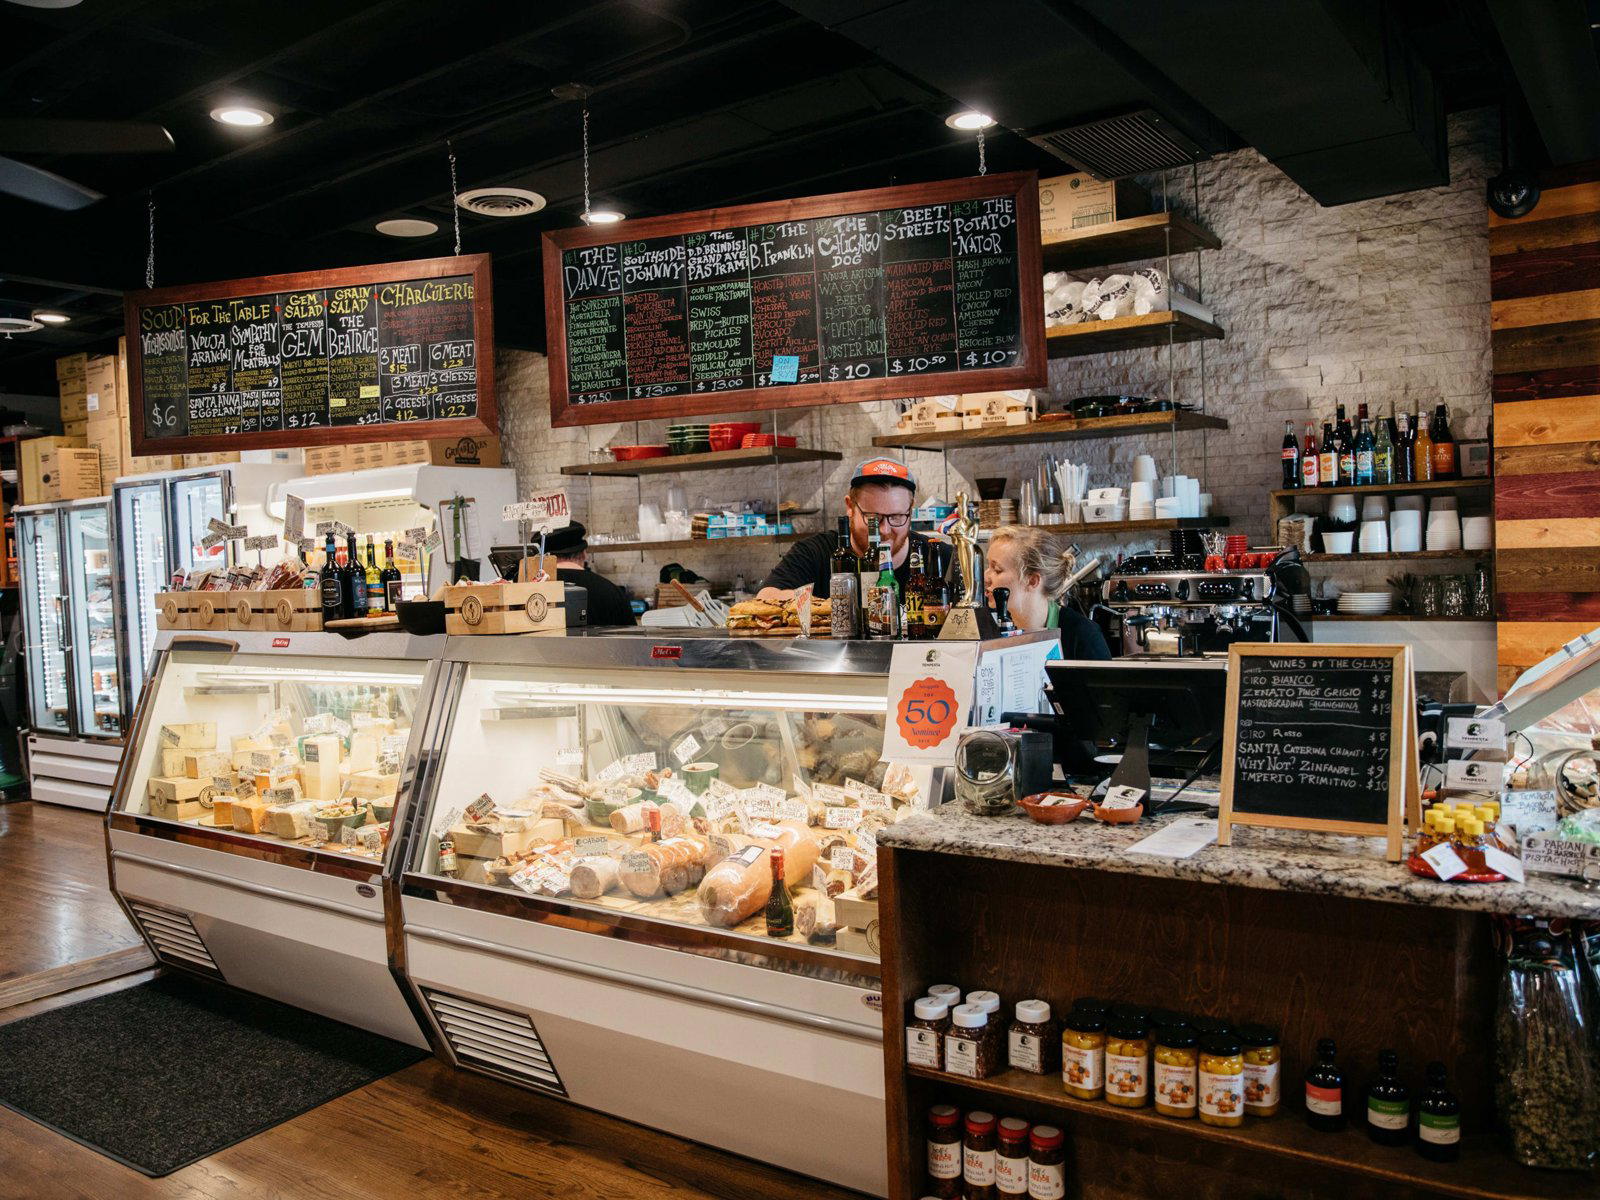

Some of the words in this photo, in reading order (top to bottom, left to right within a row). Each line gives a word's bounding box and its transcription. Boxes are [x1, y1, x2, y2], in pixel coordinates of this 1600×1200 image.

[953, 201, 978, 215] #34
[983, 199, 1013, 213] THE
[884, 211, 902, 223] #7
[902, 206, 946, 224] BEET
[751, 224, 775, 241] #13
[777, 223, 808, 237] THE
[833, 218, 867, 233] THE
[884, 220, 950, 241] STREETS
[688, 234, 706, 246] #99
[710, 231, 735, 240] THE
[818, 233, 880, 256] CHICAGO
[624, 243, 646, 255] #10
[580, 247, 617, 266] THE
[624, 246, 686, 266] SOUTHSIDE
[688, 254, 721, 266] GRAND
[832, 254, 862, 268] DOG
[688, 258, 749, 281] PASTRAMI
[957, 260, 979, 270] HASH
[982, 257, 1011, 267] BROWN
[624, 262, 684, 284] JOHNNY
[960, 268, 985, 280] PATTY
[565, 266, 621, 299] DANTE
[818, 278, 874, 295] WAGYU
[887, 276, 932, 290] MARCONA
[956, 279, 983, 290] BACON
[290, 294, 318, 306] GEM
[335, 287, 371, 300] GRAIN
[624, 293, 658, 304] ROASTED
[715, 289, 748, 302] PASTRAMI
[790, 290, 811, 300] YEAR
[835, 293, 865, 305] BEEF
[957, 291, 991, 303] PICKLED
[993, 288, 1011, 298] RED
[284, 304, 322, 318] SALAD
[330, 299, 368, 314] SALAD
[636, 297, 675, 312] PORCHETTA
[889, 299, 918, 312] APPLE
[961, 300, 989, 311] ONION
[142, 306, 183, 330] SOUP
[189, 307, 210, 325] FOR
[212, 305, 231, 323] THE
[230, 300, 270, 321] TABLE
[570, 310, 610, 321] MORTADELLA
[691, 306, 721, 318] SWISS
[825, 307, 846, 319] HOT
[849, 304, 871, 318] DOG
[959, 309, 1000, 320] AMERICAN
[339, 315, 364, 328] THE
[754, 318, 795, 329] SPROUTS
[888, 320, 927, 332] PICKLED
[929, 317, 946, 328] RED
[963, 319, 994, 327] CHEESE
[569, 329, 588, 337] COPPA
[705, 327, 741, 338] PICKLES
[754, 327, 790, 339] AVOCADO
[960, 327, 978, 338] EGG
[282, 328, 324, 358] GEM
[328, 327, 378, 358] BEATRICE
[570, 335, 607, 347] PORCHETTA
[691, 338, 740, 352] REMOULADE
[960, 338, 993, 348] BRIOCHE
[995, 335, 1015, 344] BUN
[381, 350, 389, 365] 3
[392, 346, 417, 364] MEAT
[432, 345, 441, 360] 6
[442, 344, 472, 359] MEAT
[570, 344, 606, 354] PROVOLONE
[821, 342, 862, 359] LOBSTER
[865, 340, 886, 355] ROLL
[191, 348, 231, 366] ARANCINI
[234, 350, 280, 371] MEATBALLS
[692, 351, 728, 362] GRIDDLED
[692, 361, 726, 372] PUBLICAN
[728, 357, 752, 367] QUALITY
[393, 376, 400, 387] 3
[440, 371, 476, 382] CHEESE
[695, 371, 723, 379] SEEDED
[724, 368, 741, 376] RYE
[212, 383, 226, 392] $8
[581, 378, 620, 391] BAGUETTE
[190, 397, 217, 408] SANTA
[218, 395, 240, 407] ANNA
[242, 399, 259, 407] SALAD
[386, 399, 393, 409] 2
[395, 398, 426, 408] CHEESE
[445, 394, 477, 404] CHEESE
[152, 403, 177, 427] $6
[190, 406, 242, 419] EGGPLANT
[441, 406, 466, 417] $22
[289, 412, 319, 427] $12
[225, 426, 237, 434] $7
[907, 596, 924, 611] 312
[1270, 660, 1306, 668] WINES
[1312, 660, 1324, 668] BY
[1352, 660, 1391, 668] GLASS
[1243, 676, 1267, 684] CIRO
[1272, 675, 1313, 685] BIANCO
[1243, 689, 1295, 697] ZENATO
[1298, 688, 1320, 696] PINOT
[1324, 688, 1360, 697] GRIGIO
[1372, 689, 1387, 699] $8
[906, 700, 950, 724] 50
[1240, 730, 1265, 739] CIRO
[1239, 742, 1280, 755] SANTA
[1284, 744, 1326, 756] CATERINA
[1238, 756, 1265, 770] WHY
[1299, 760, 1359, 775] ZINFANDEL
[1367, 765, 1384, 778] $9
[1298, 774, 1356, 788] PRIMITIVO
